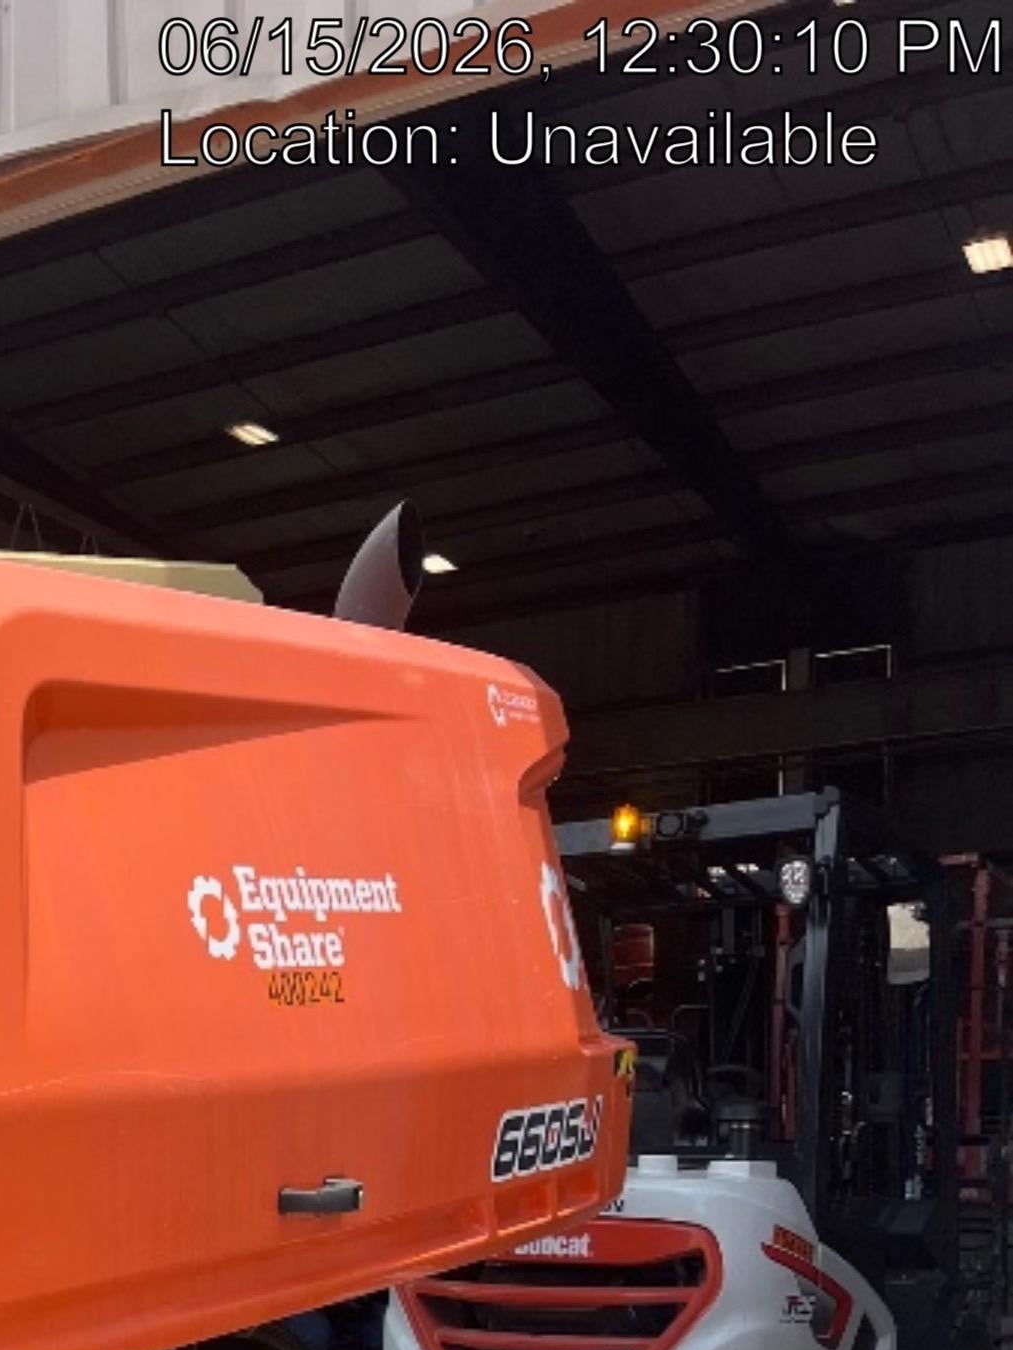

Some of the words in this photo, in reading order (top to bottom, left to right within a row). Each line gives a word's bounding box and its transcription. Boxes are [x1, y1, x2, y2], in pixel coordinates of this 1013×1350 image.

[232, 865, 403, 922] Equipment
[246, 922, 345, 970] Share
[490, 1094, 604, 1183] 660SJ
